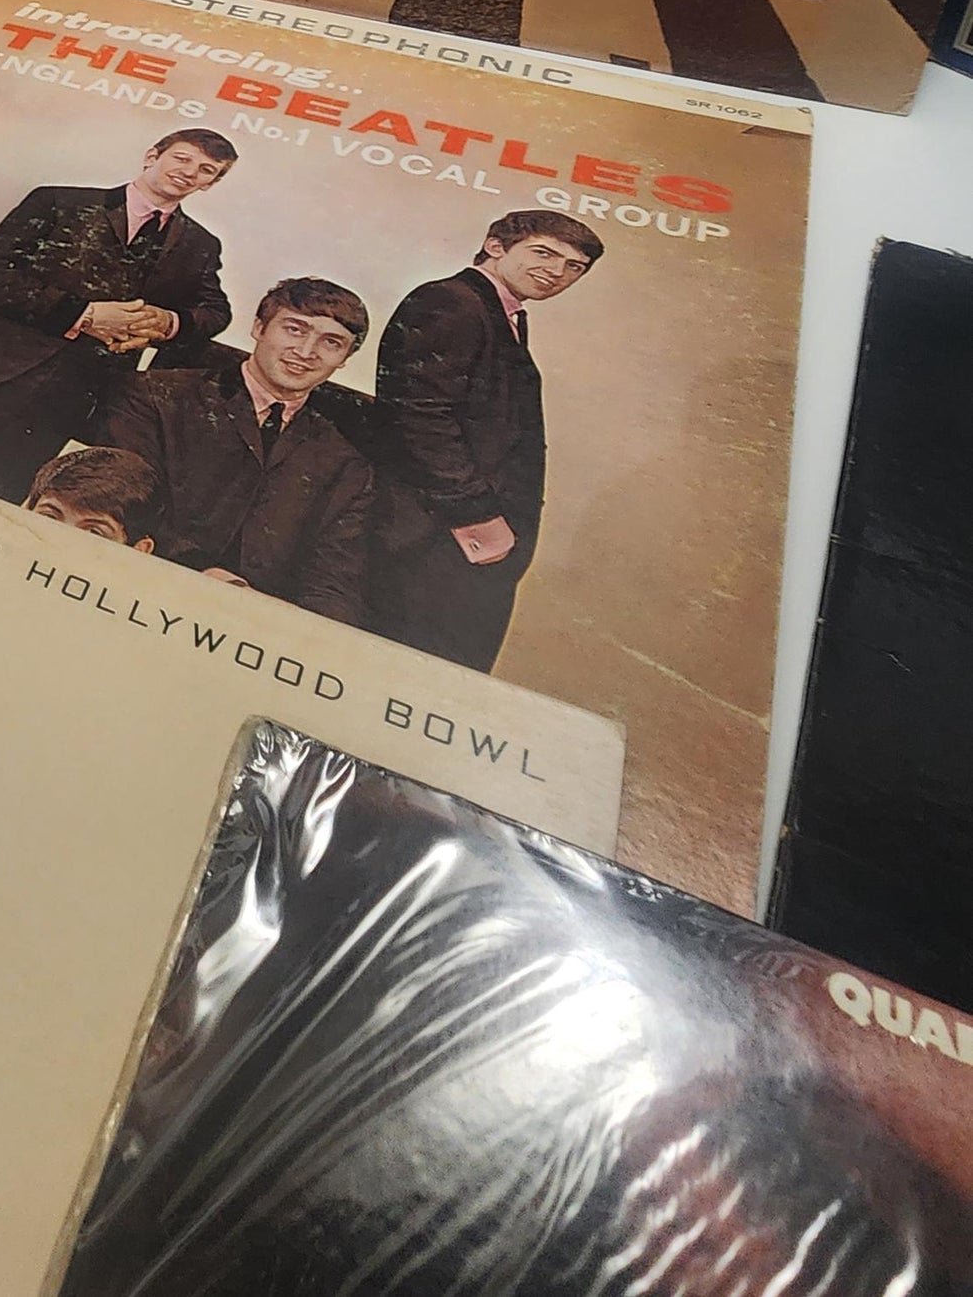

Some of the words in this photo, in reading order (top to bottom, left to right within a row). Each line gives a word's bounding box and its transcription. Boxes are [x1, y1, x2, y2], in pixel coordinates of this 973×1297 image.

[14, 2, 363, 94] introducing...
[2, 23, 177, 84] THE
[215, 74, 734, 214] BEATLES
[685, 99, 711, 110] SR
[716, 104, 763, 120] 1062
[331, 134, 501, 195] VOCAL
[534, 186, 732, 243] GROUP
[25, 559, 345, 701] HOLLYWOOD
[384, 697, 547, 782] BOWL
